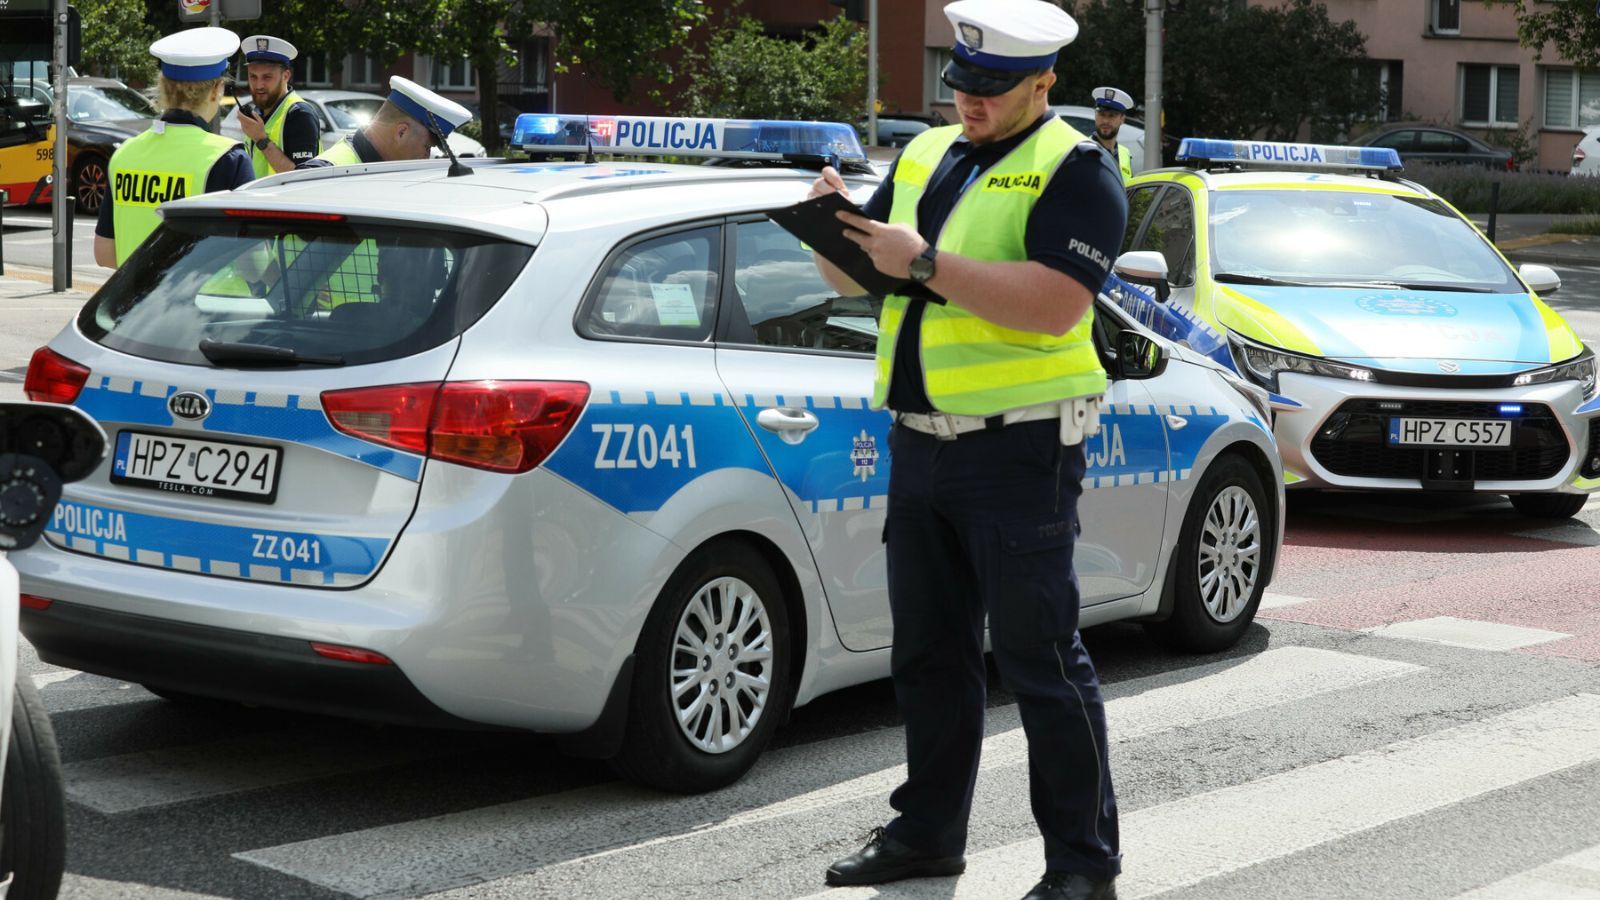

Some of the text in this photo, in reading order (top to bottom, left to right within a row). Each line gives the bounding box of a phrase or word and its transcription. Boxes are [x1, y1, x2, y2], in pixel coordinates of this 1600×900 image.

[615, 120, 717, 150] POLICJA
[292, 151, 313, 159] POLICJA
[1251, 143, 1322, 163] POLICJA
[115, 172, 186, 204] POLICJA
[987, 174, 1040, 190] POLICJA
[174, 396, 202, 415] KIA
[1403, 420, 1507, 445] HPZ C557
[591, 423, 697, 469] ZZ041
[116, 459, 126, 471] PL
[132, 438, 271, 490] HPZ C294
[159, 481, 214, 495] TESLA.COM
[54, 502, 127, 542] POLICJA
[252, 533, 320, 564] ZZ041
